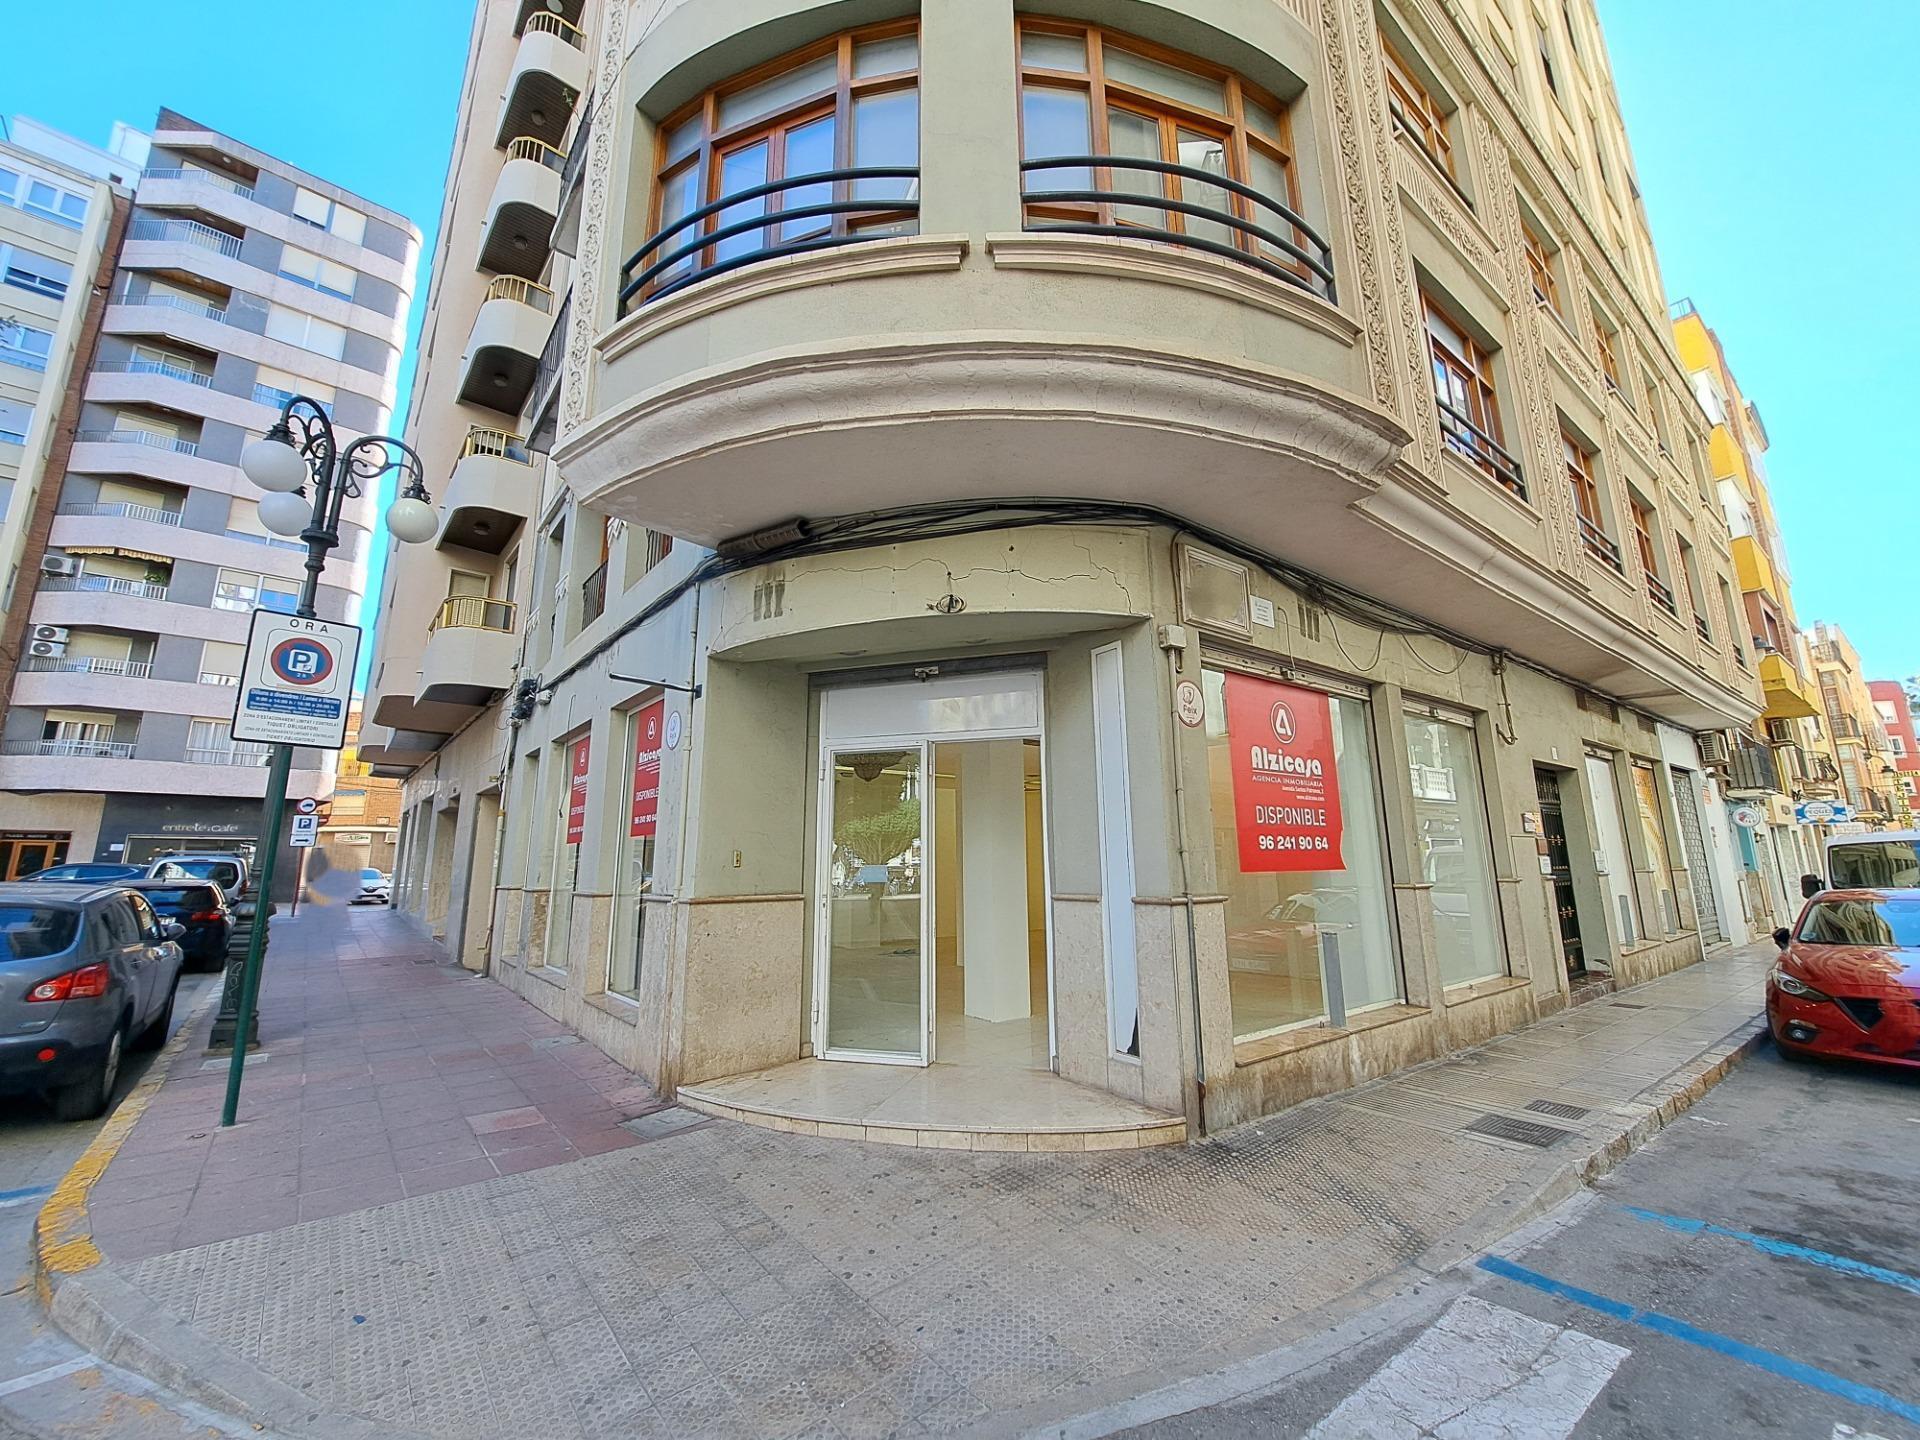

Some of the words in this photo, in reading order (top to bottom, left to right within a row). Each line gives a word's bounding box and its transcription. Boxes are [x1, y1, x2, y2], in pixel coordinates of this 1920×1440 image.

[290, 618, 328, 633] ORA
[292, 652, 312, 668] P
[1251, 746, 1322, 778] Alzicasa
[1252, 775, 1282, 783] AGENCIA
[1282, 777, 1324, 788] INMOBILIARIA
[1256, 806, 1326, 826] DISPONIBLE
[1258, 835, 1274, 850] 96
[1277, 836, 1296, 850] 241
[1298, 836, 1313, 850] 90
[1315, 836, 1329, 850] 64
